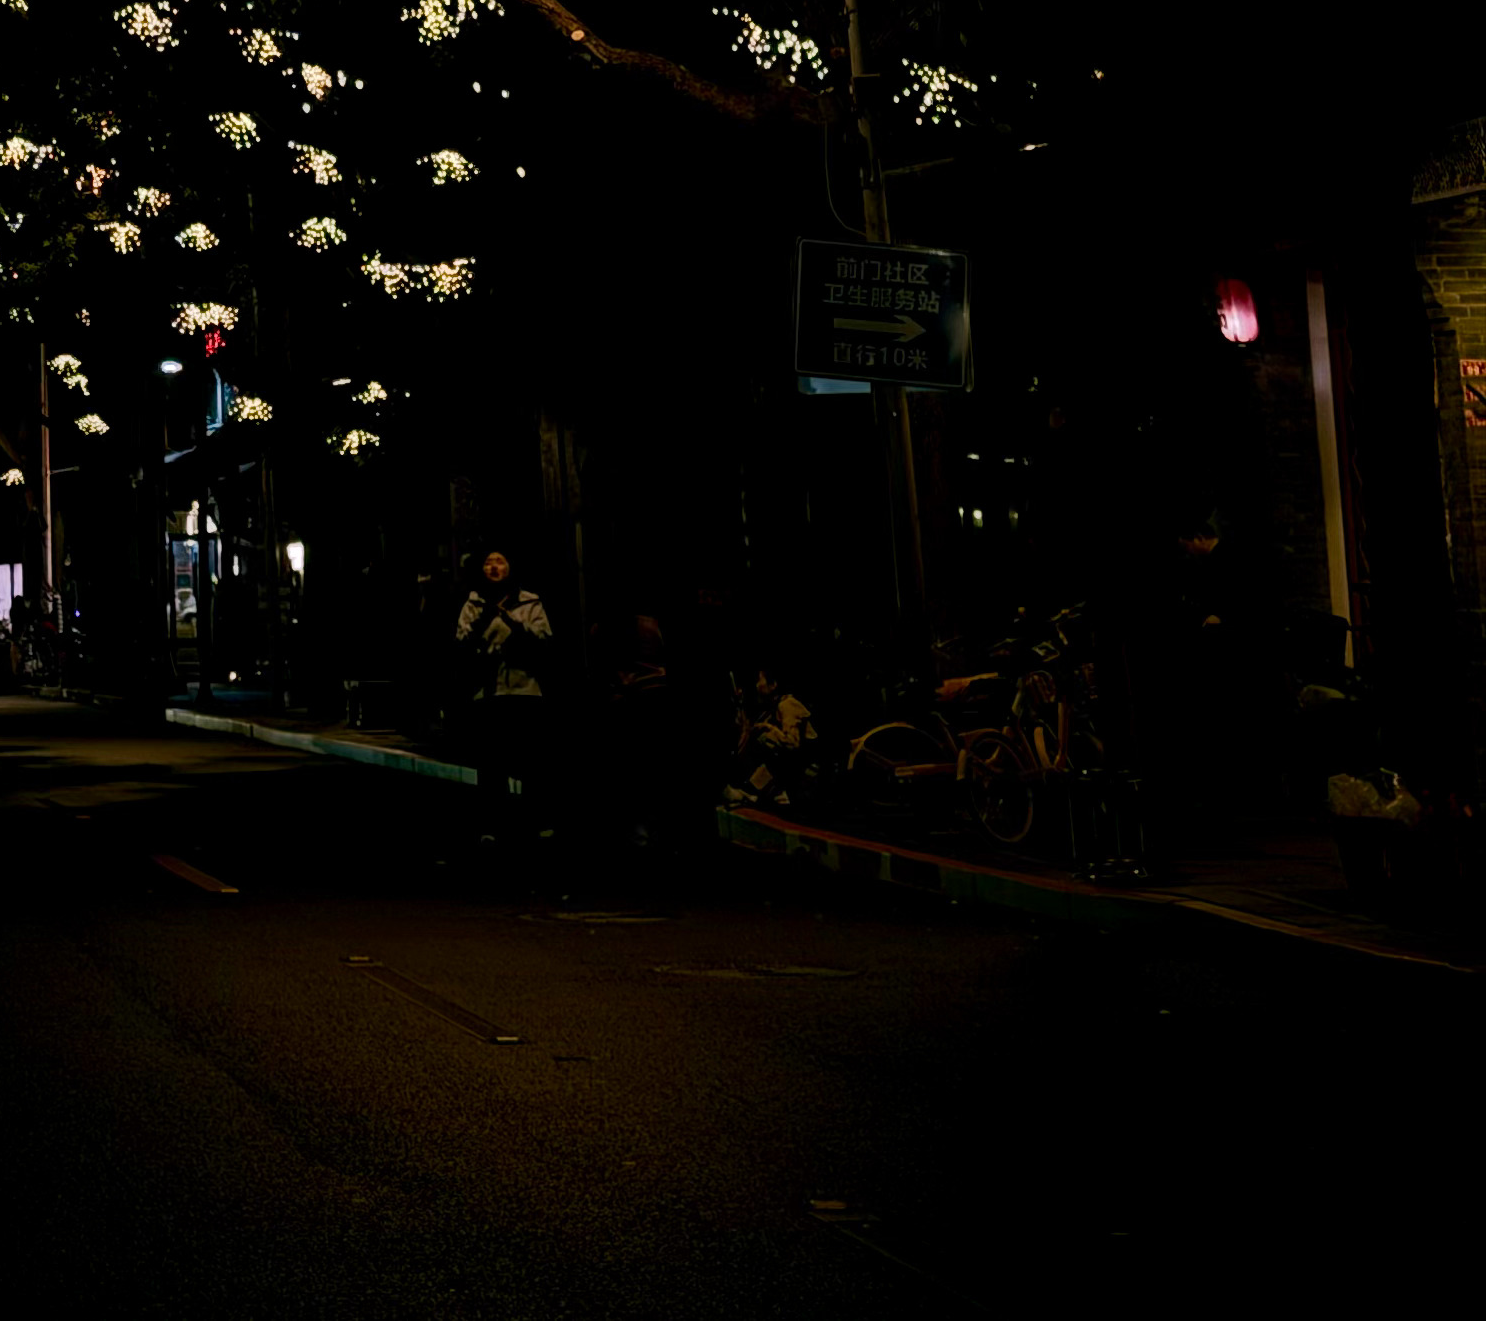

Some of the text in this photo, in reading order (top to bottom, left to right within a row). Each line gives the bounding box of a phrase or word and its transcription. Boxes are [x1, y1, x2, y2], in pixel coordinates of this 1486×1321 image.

[836, 256, 929, 285] 前门社区
[822, 283, 941, 314] 卫生服务站
